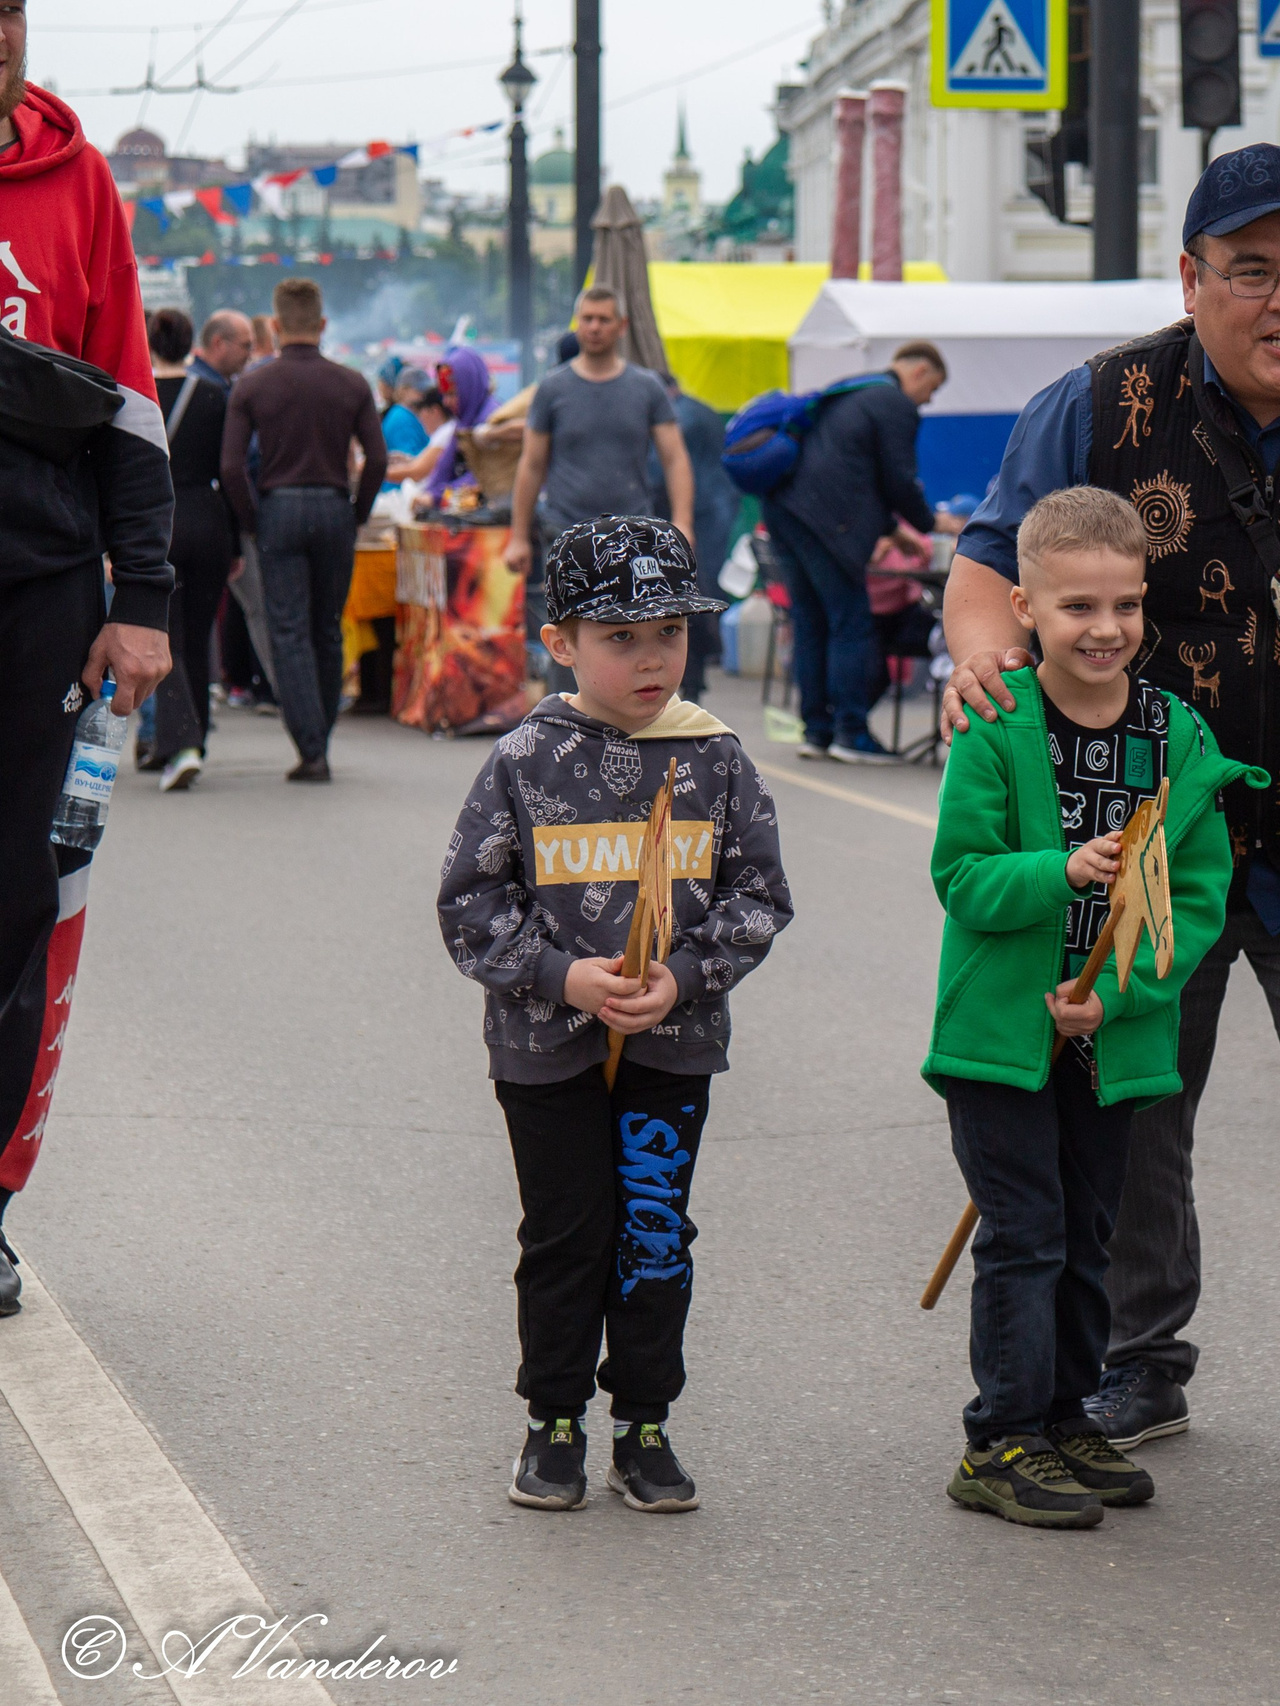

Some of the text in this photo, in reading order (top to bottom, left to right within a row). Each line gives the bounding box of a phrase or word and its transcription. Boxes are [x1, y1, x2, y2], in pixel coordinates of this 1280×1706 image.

[606, 744, 638, 756] POPCORN
[673, 779, 697, 797] FUN
[535, 830, 711, 875] YUMY!
[586, 888, 606, 902] SODA
